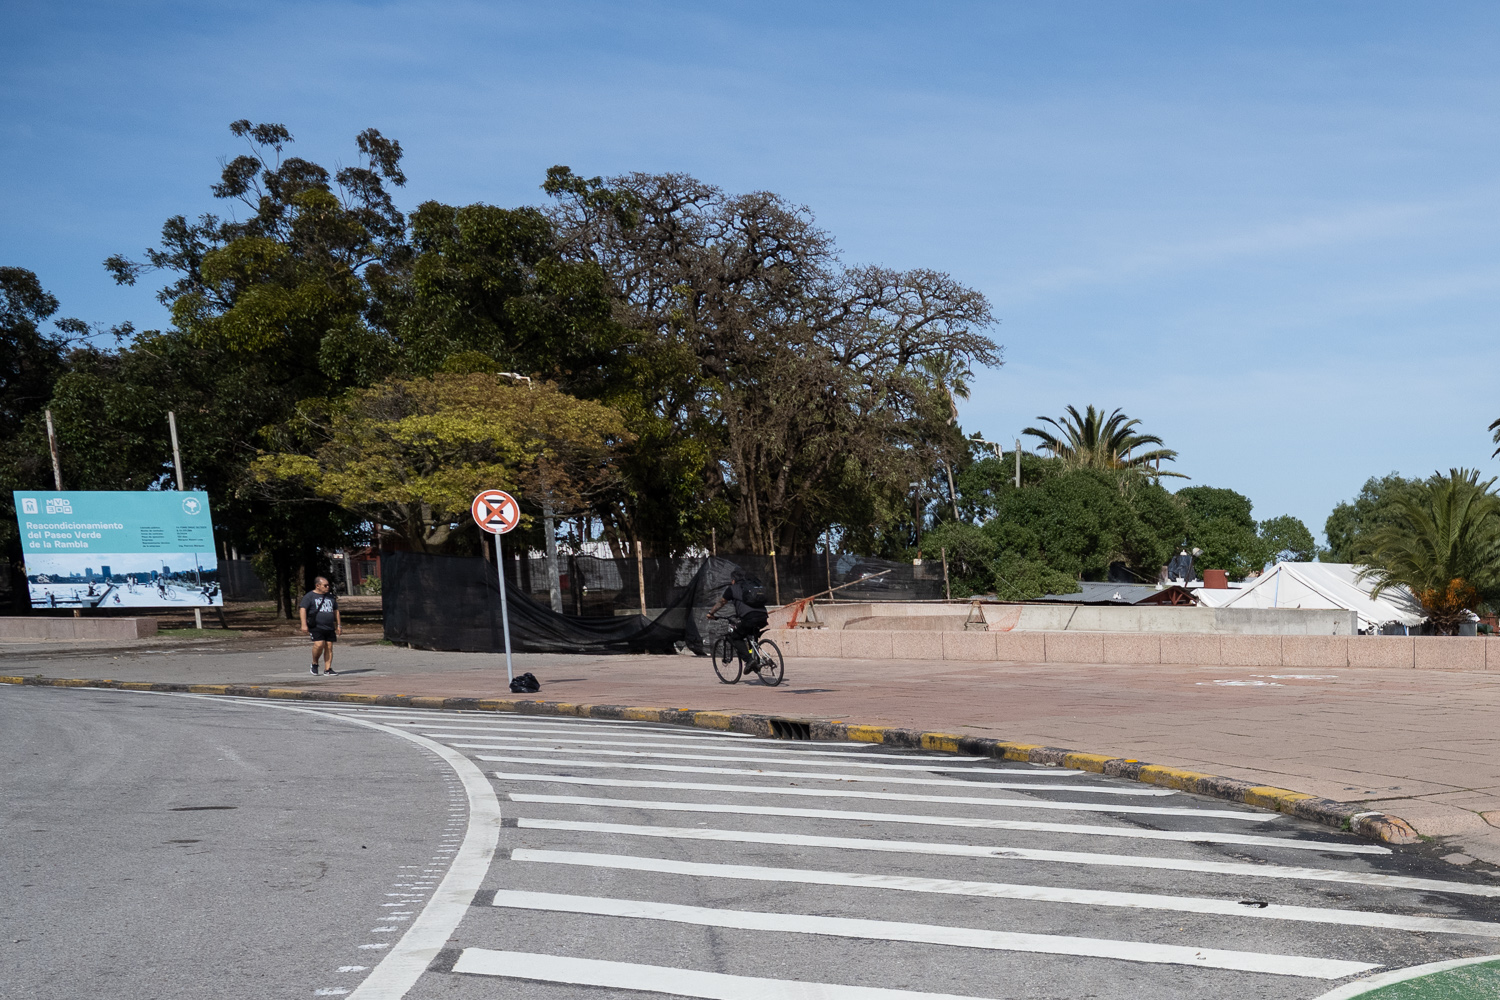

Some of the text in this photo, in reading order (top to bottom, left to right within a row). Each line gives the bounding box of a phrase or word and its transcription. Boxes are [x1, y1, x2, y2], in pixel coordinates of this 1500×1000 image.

[26, 522, 124, 530] Reacondicionamiento
[27, 531, 102, 539] del Paseo Verde
